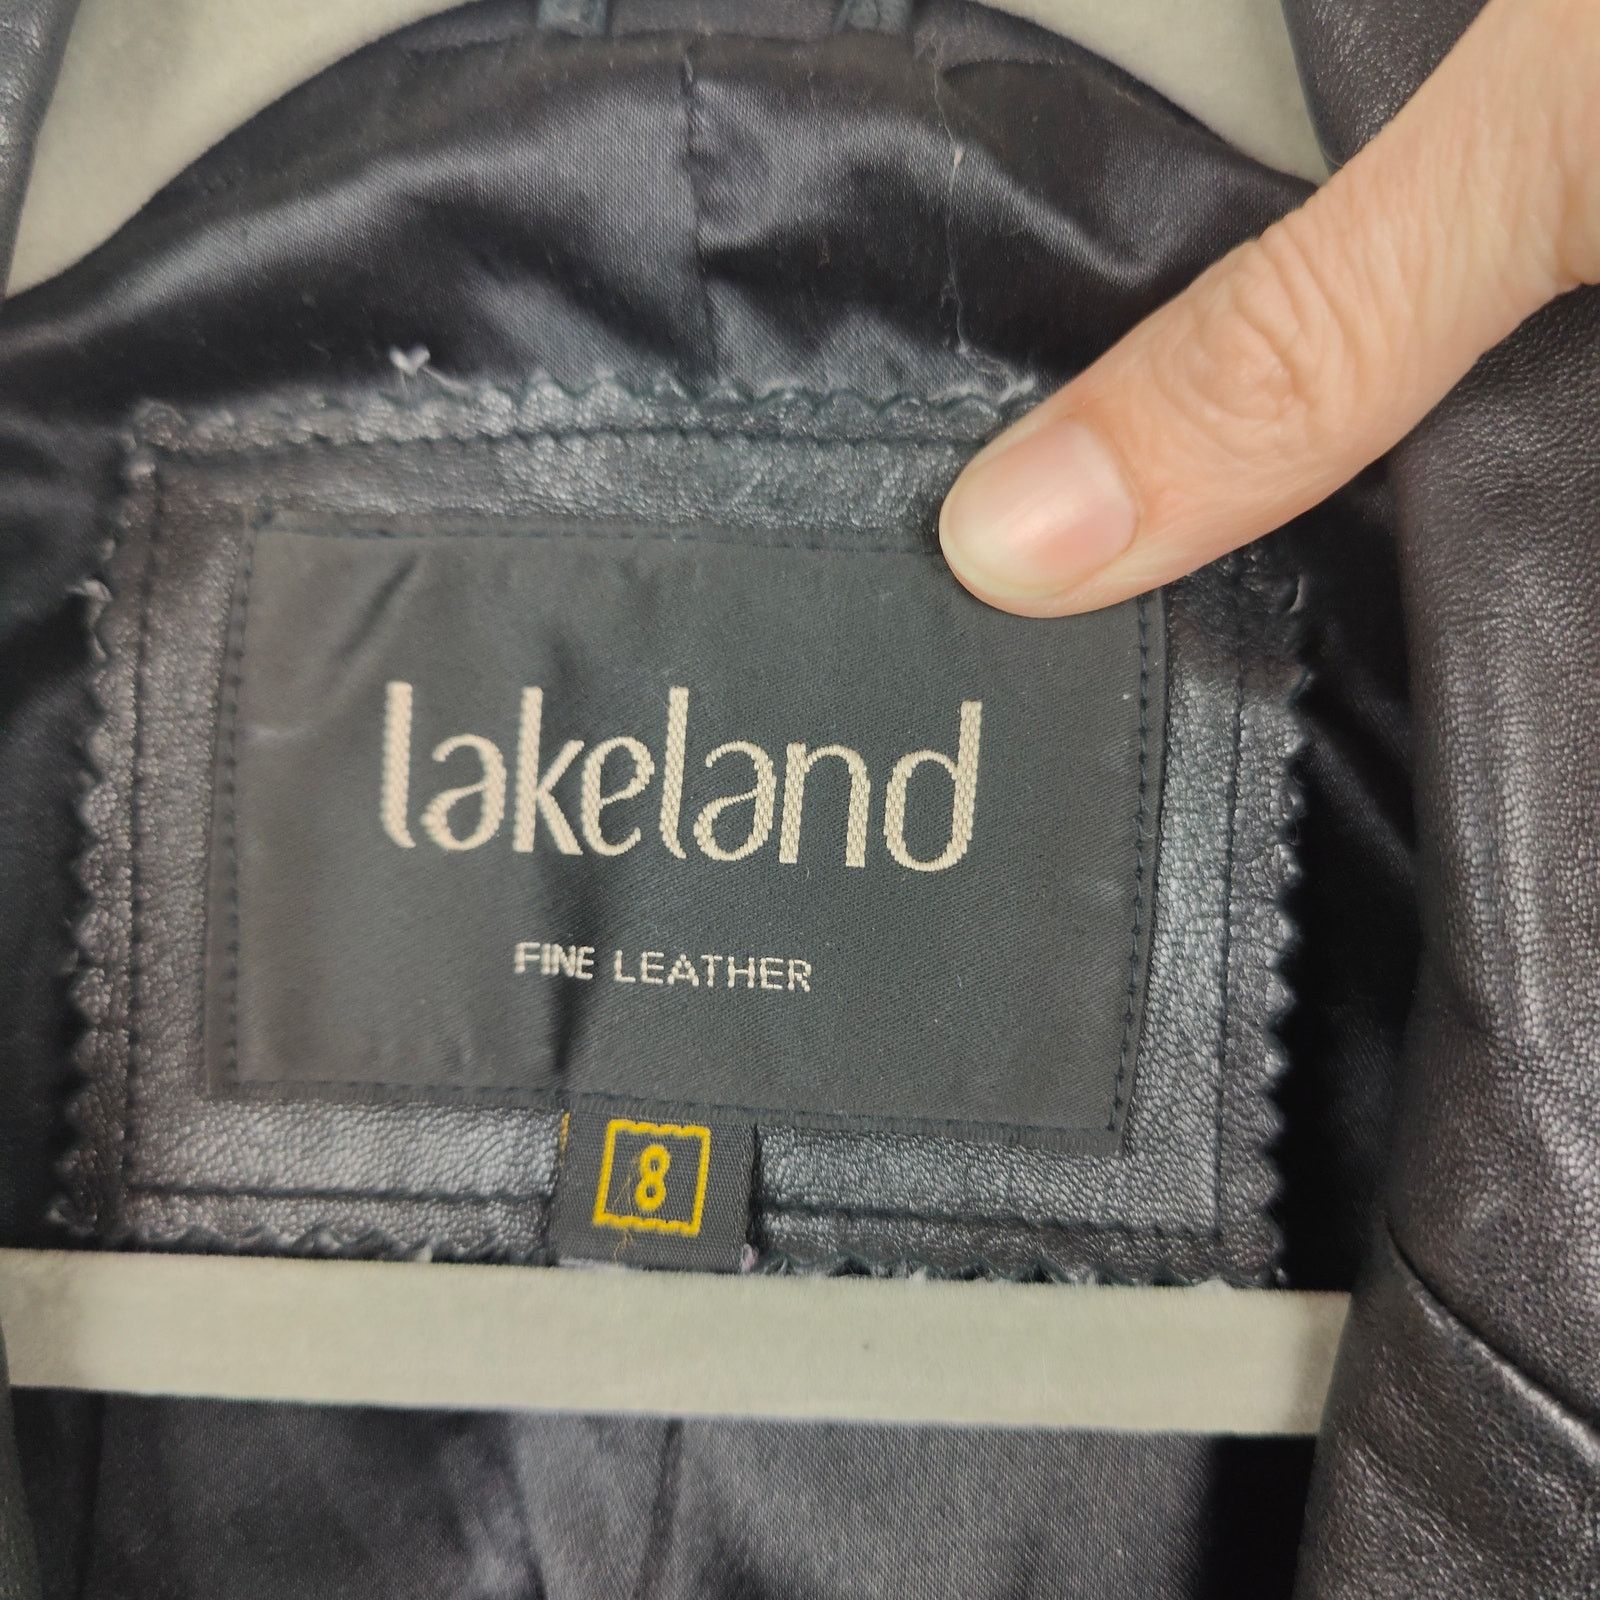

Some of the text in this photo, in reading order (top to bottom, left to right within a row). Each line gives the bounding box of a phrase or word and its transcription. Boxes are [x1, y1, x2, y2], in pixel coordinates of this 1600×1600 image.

[379, 681, 983, 872] lakeland
[513, 941, 813, 993] FINE LEATHER
[632, 1143, 672, 1215] 8
